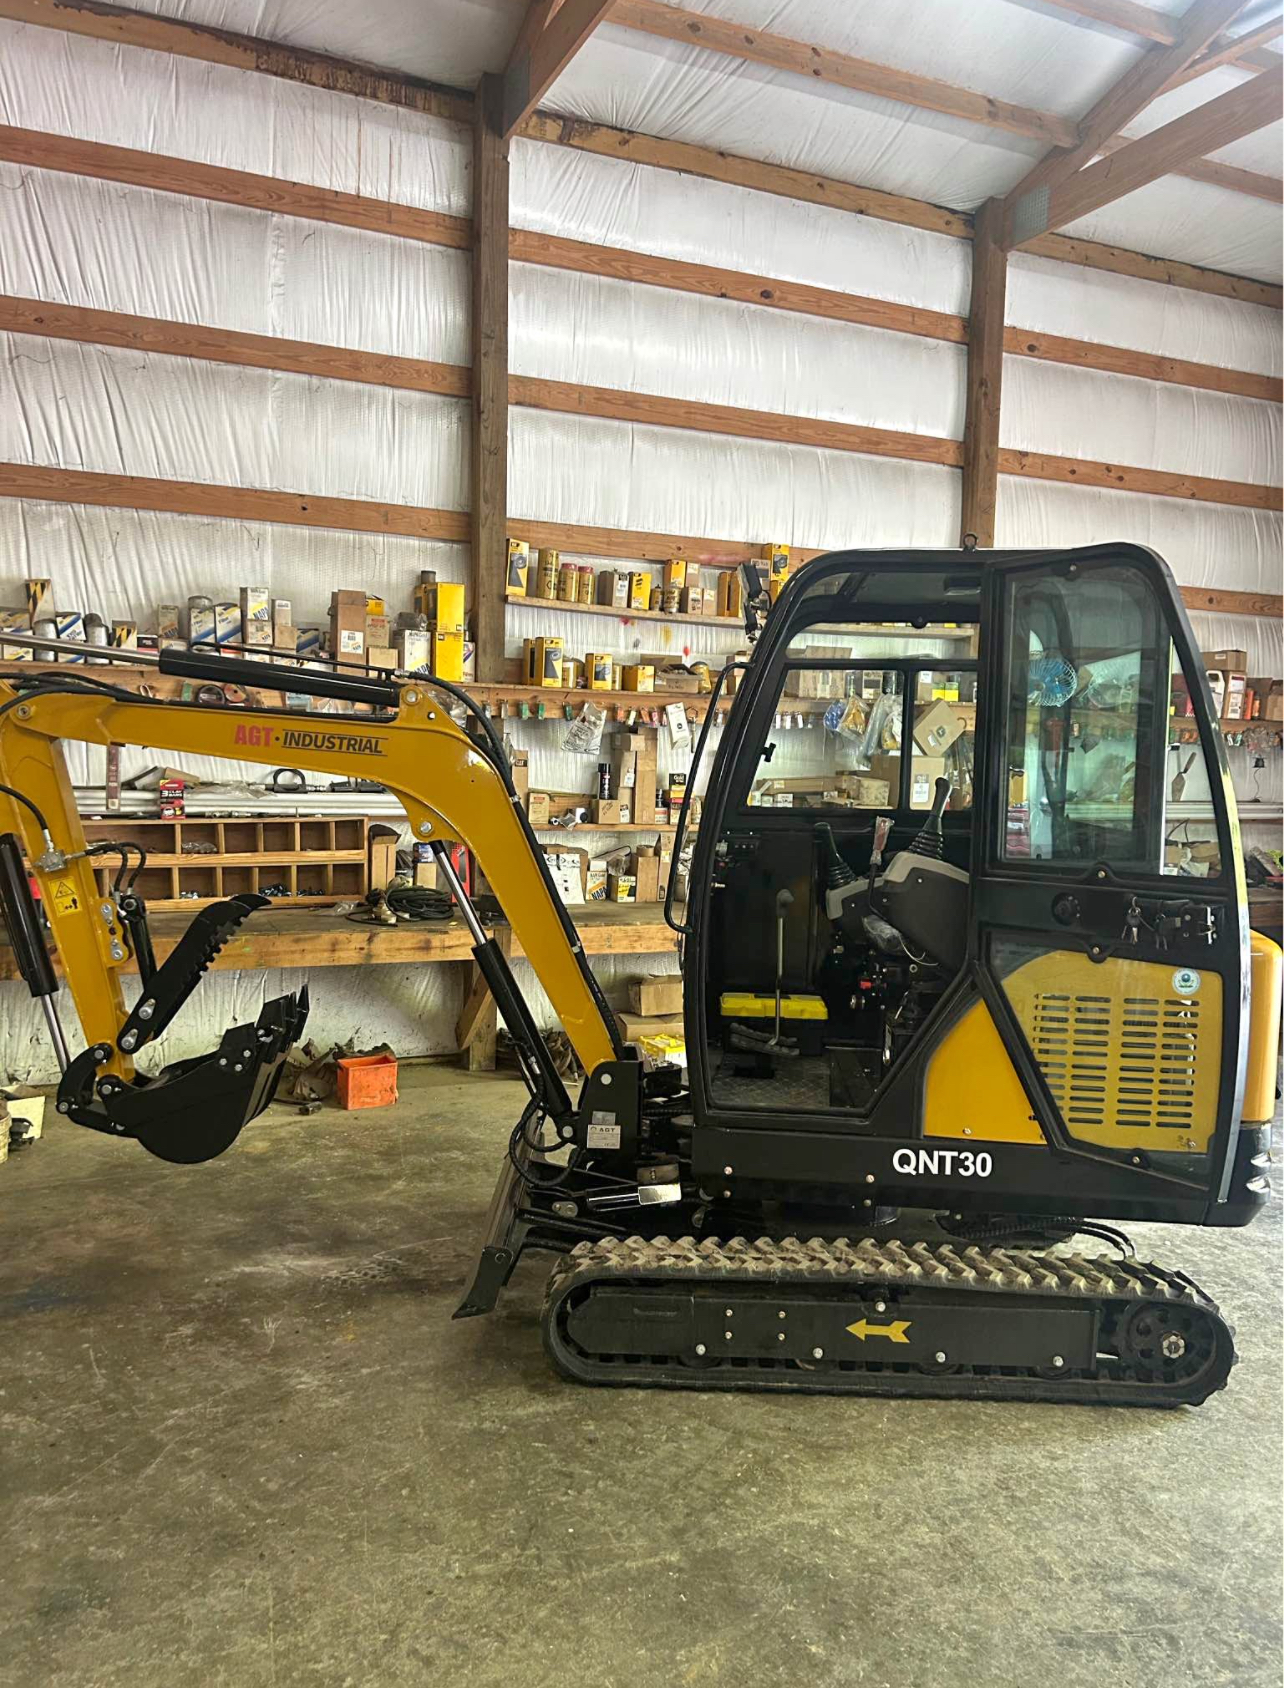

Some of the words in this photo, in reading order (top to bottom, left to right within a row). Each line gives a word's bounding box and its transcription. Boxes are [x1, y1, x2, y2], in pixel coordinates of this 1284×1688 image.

[234, 724, 274, 747] AGT
[283, 731, 383, 754] INDUSTRIAL
[161, 790, 169, 798] 3
[892, 1148, 993, 1178] QNT30
